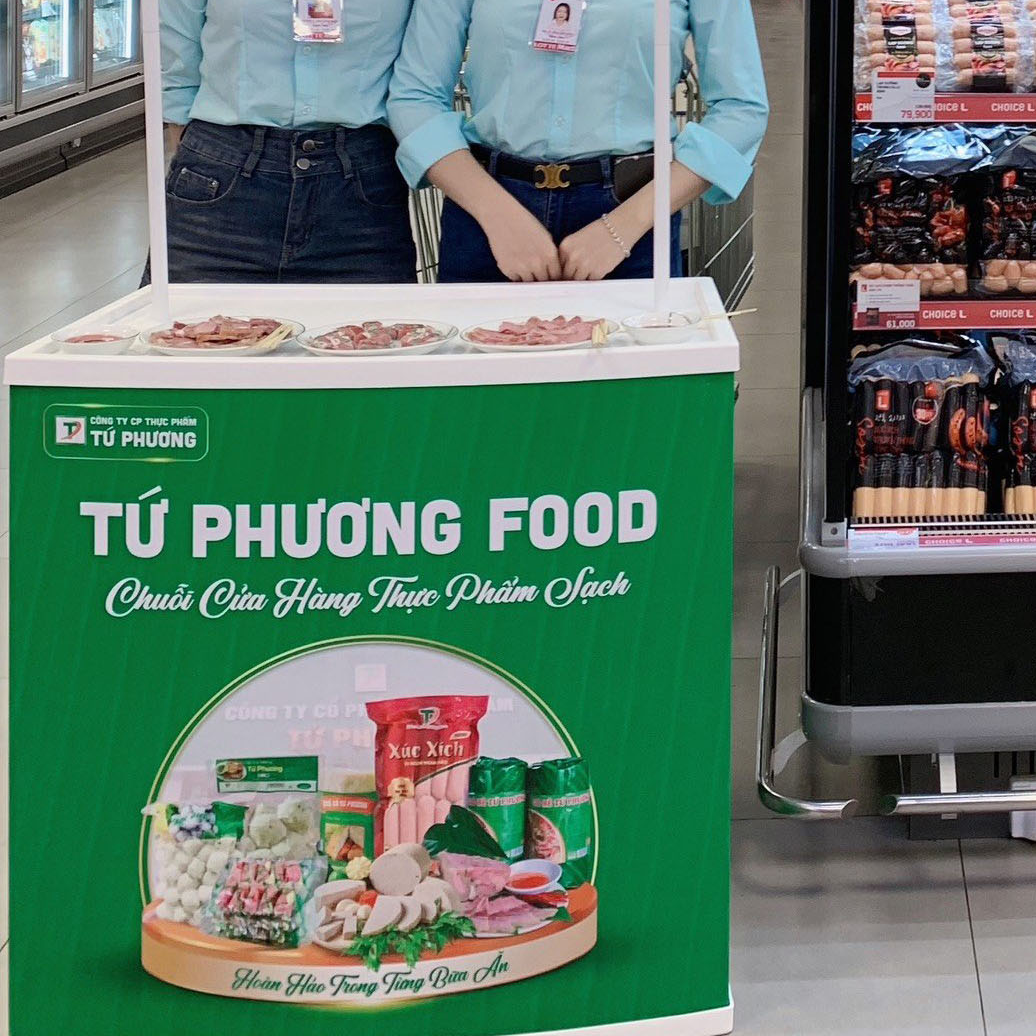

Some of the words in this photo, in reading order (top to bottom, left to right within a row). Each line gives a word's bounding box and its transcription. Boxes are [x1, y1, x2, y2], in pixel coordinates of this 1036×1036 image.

[901, 110, 933, 120] 79,900
[89, 415, 114, 427] CÔNG
[117, 416, 129, 427] TY
[130, 417, 142, 427] CP
[144, 416, 169, 429] THỰC
[171, 414, 197, 427] PHẨM
[91, 428, 118, 448] TỨ
[121, 430, 197, 448] PHƯƠNG
[80, 485, 169, 558] TỨ
[192, 497, 462, 558] PHƯƠNG
[489, 489, 659, 551] FOOD
[105, 576, 194, 618] Chuỗi
[199, 576, 268, 619] Cửa
[272, 577, 363, 619] Hàng
[368, 575, 440, 616] Thực
[445, 570, 539, 610] Phẩm
[544, 566, 631, 608] Sạch
[388, 741, 421, 760] Xúc
[426, 740, 465, 758] Xích
[231, 968, 283, 993] Hoàn
[285, 974, 325, 997] Hảo
[329, 975, 378, 998] Trong
[382, 970, 425, 995] Từng
[429, 966, 469, 989] Bữa
[473, 953, 509, 984] Ăn
